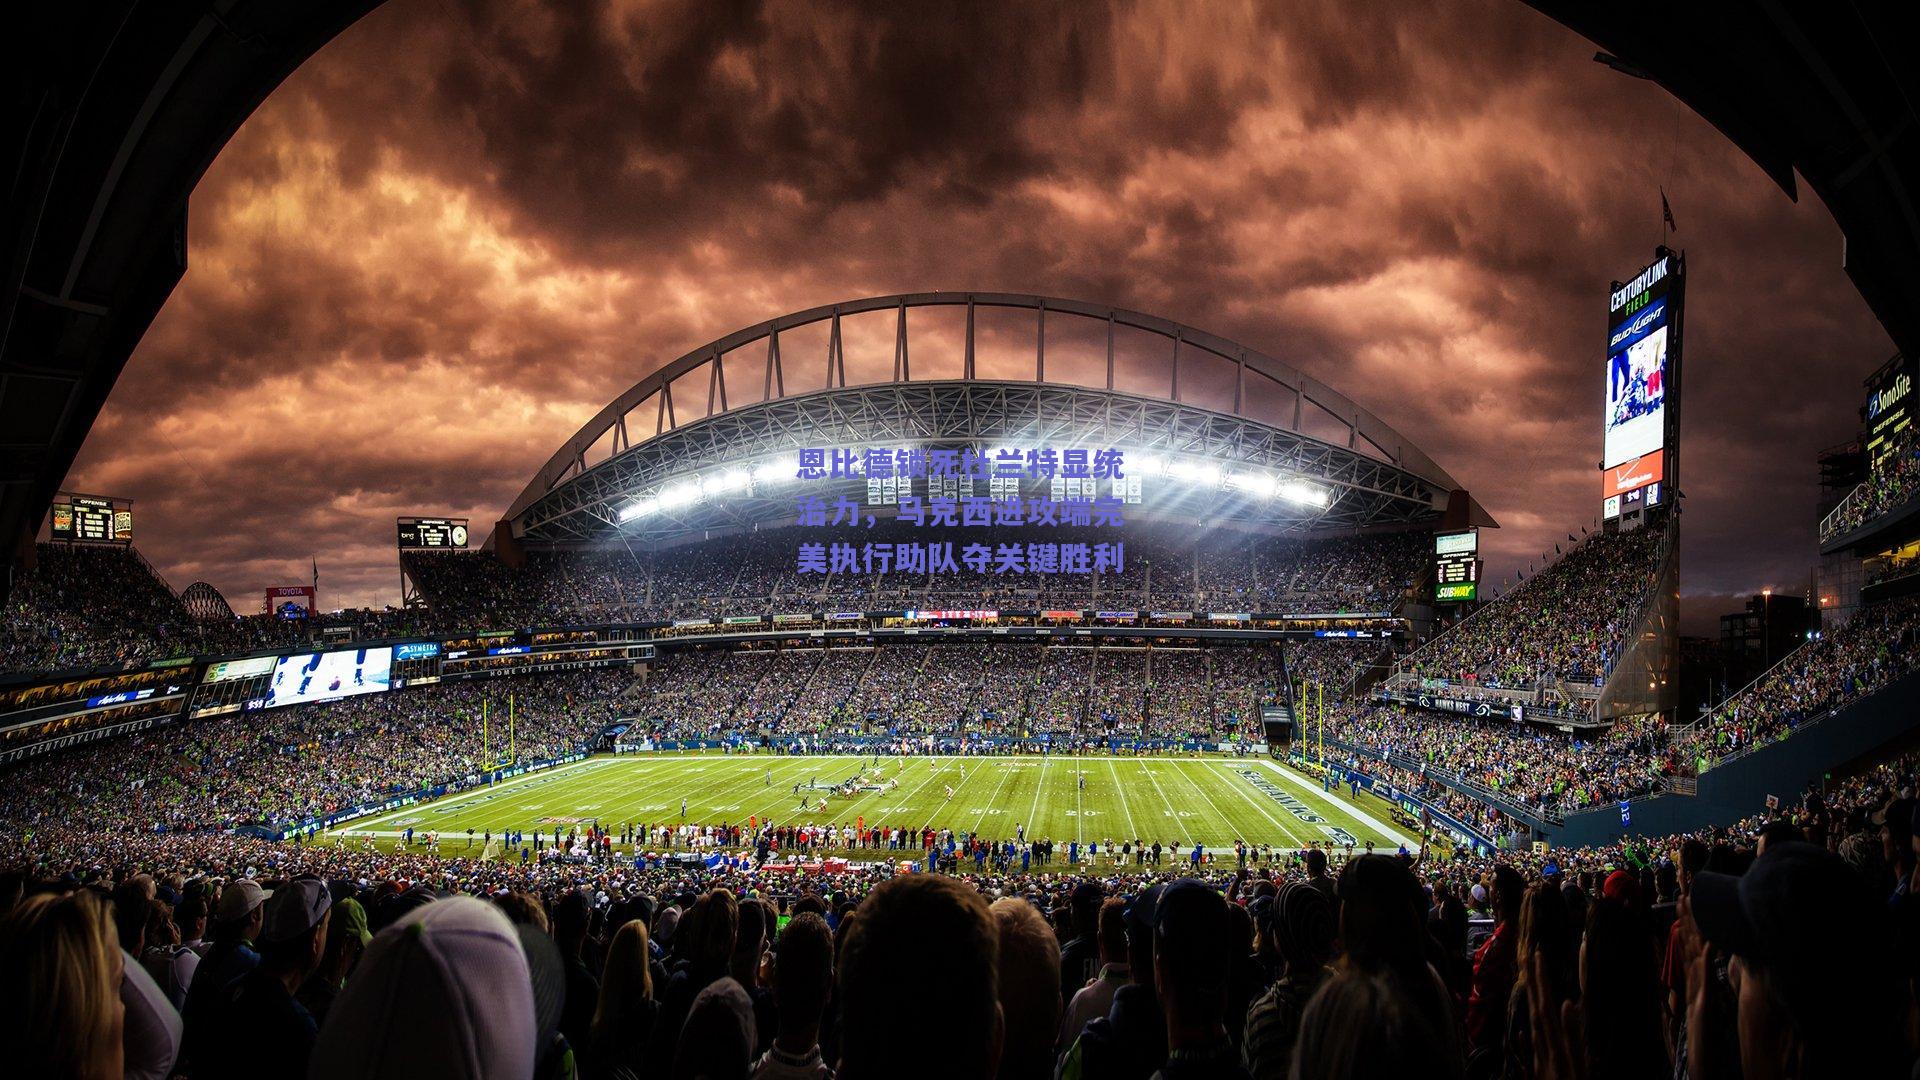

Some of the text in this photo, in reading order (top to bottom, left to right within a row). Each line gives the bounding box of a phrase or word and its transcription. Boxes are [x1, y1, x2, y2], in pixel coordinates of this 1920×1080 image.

[1610, 256, 1669, 312] CENTURYLINK
[1625, 290, 1650, 317] FIELD
[1610, 327, 1632, 347] BUD
[1877, 373, 1911, 414] SonoSite
[80, 499, 107, 507] OFFENSE
[278, 588, 303, 596] TOYOTA
[1437, 586, 1475, 599] SUBWAY
[409, 644, 438, 652] SYMETRA
[490, 660, 609, 677] HOME OF THE 12TH MAN
[9, 752, 23, 762] TO
[30, 728, 112, 756] CENTURYLINK
[117, 720, 153, 735] FIELD
[1233, 769, 1330, 823] SEAHAWKS
[1620, 806, 1630, 822] 12
